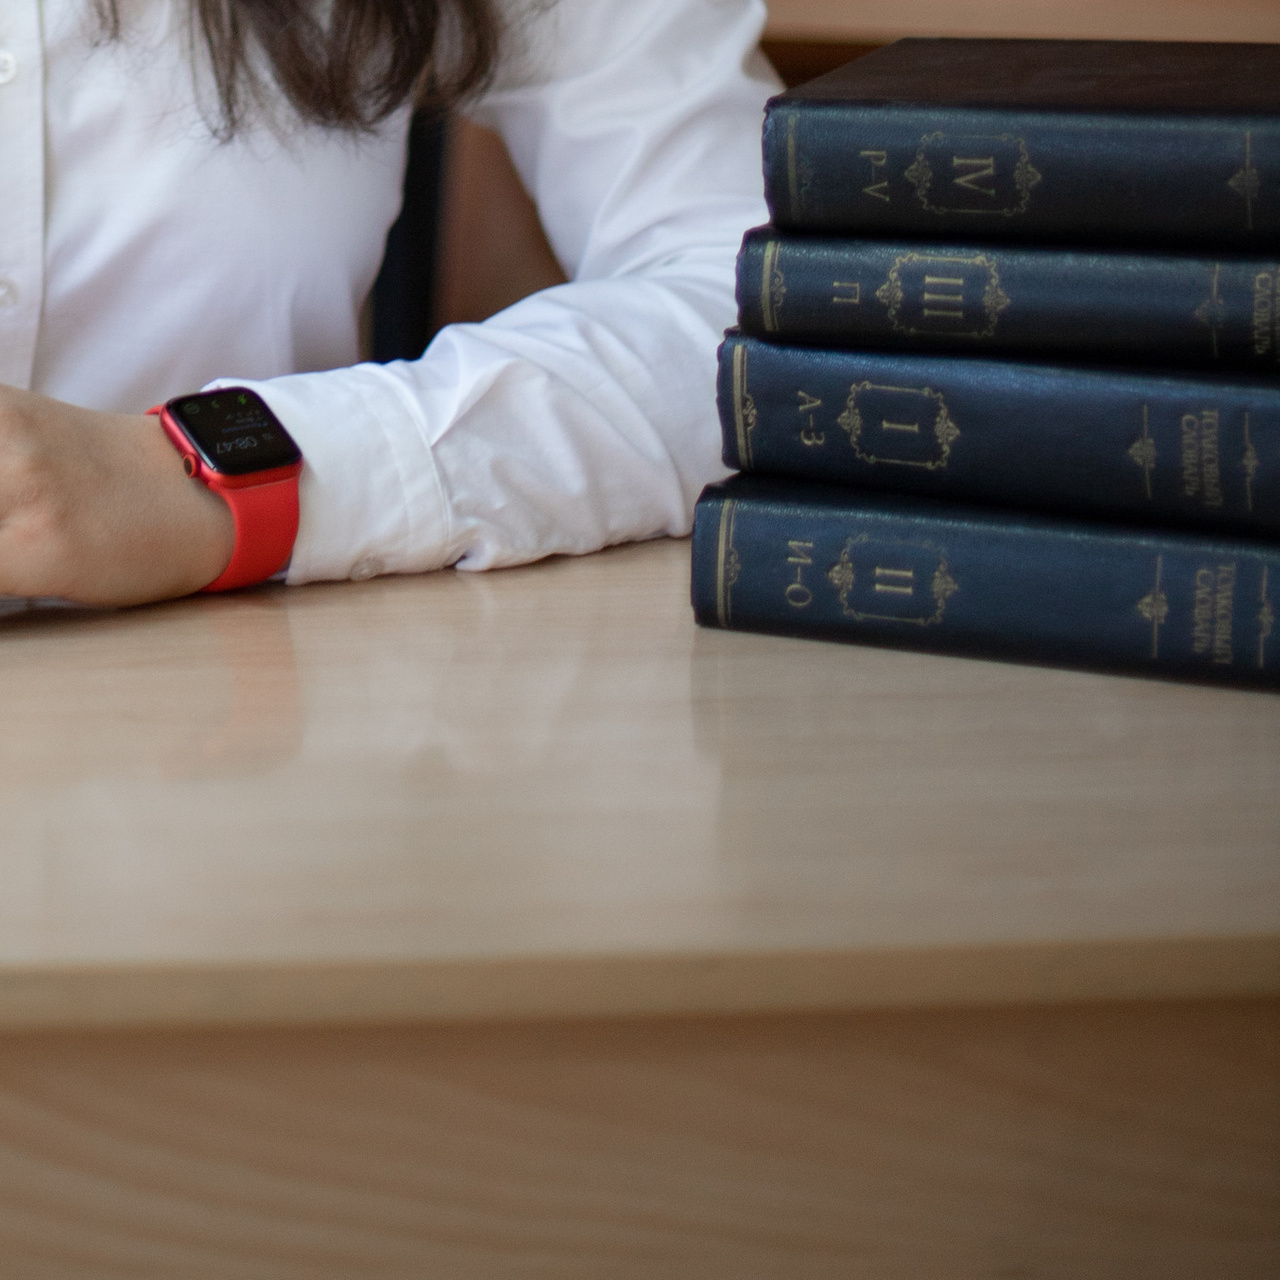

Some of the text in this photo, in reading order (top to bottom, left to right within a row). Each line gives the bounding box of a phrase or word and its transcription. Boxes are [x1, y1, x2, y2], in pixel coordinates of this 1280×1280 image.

[952, 155, 996, 197] IV
[923, 275, 964, 317] III
[874, 566, 914, 596] II
